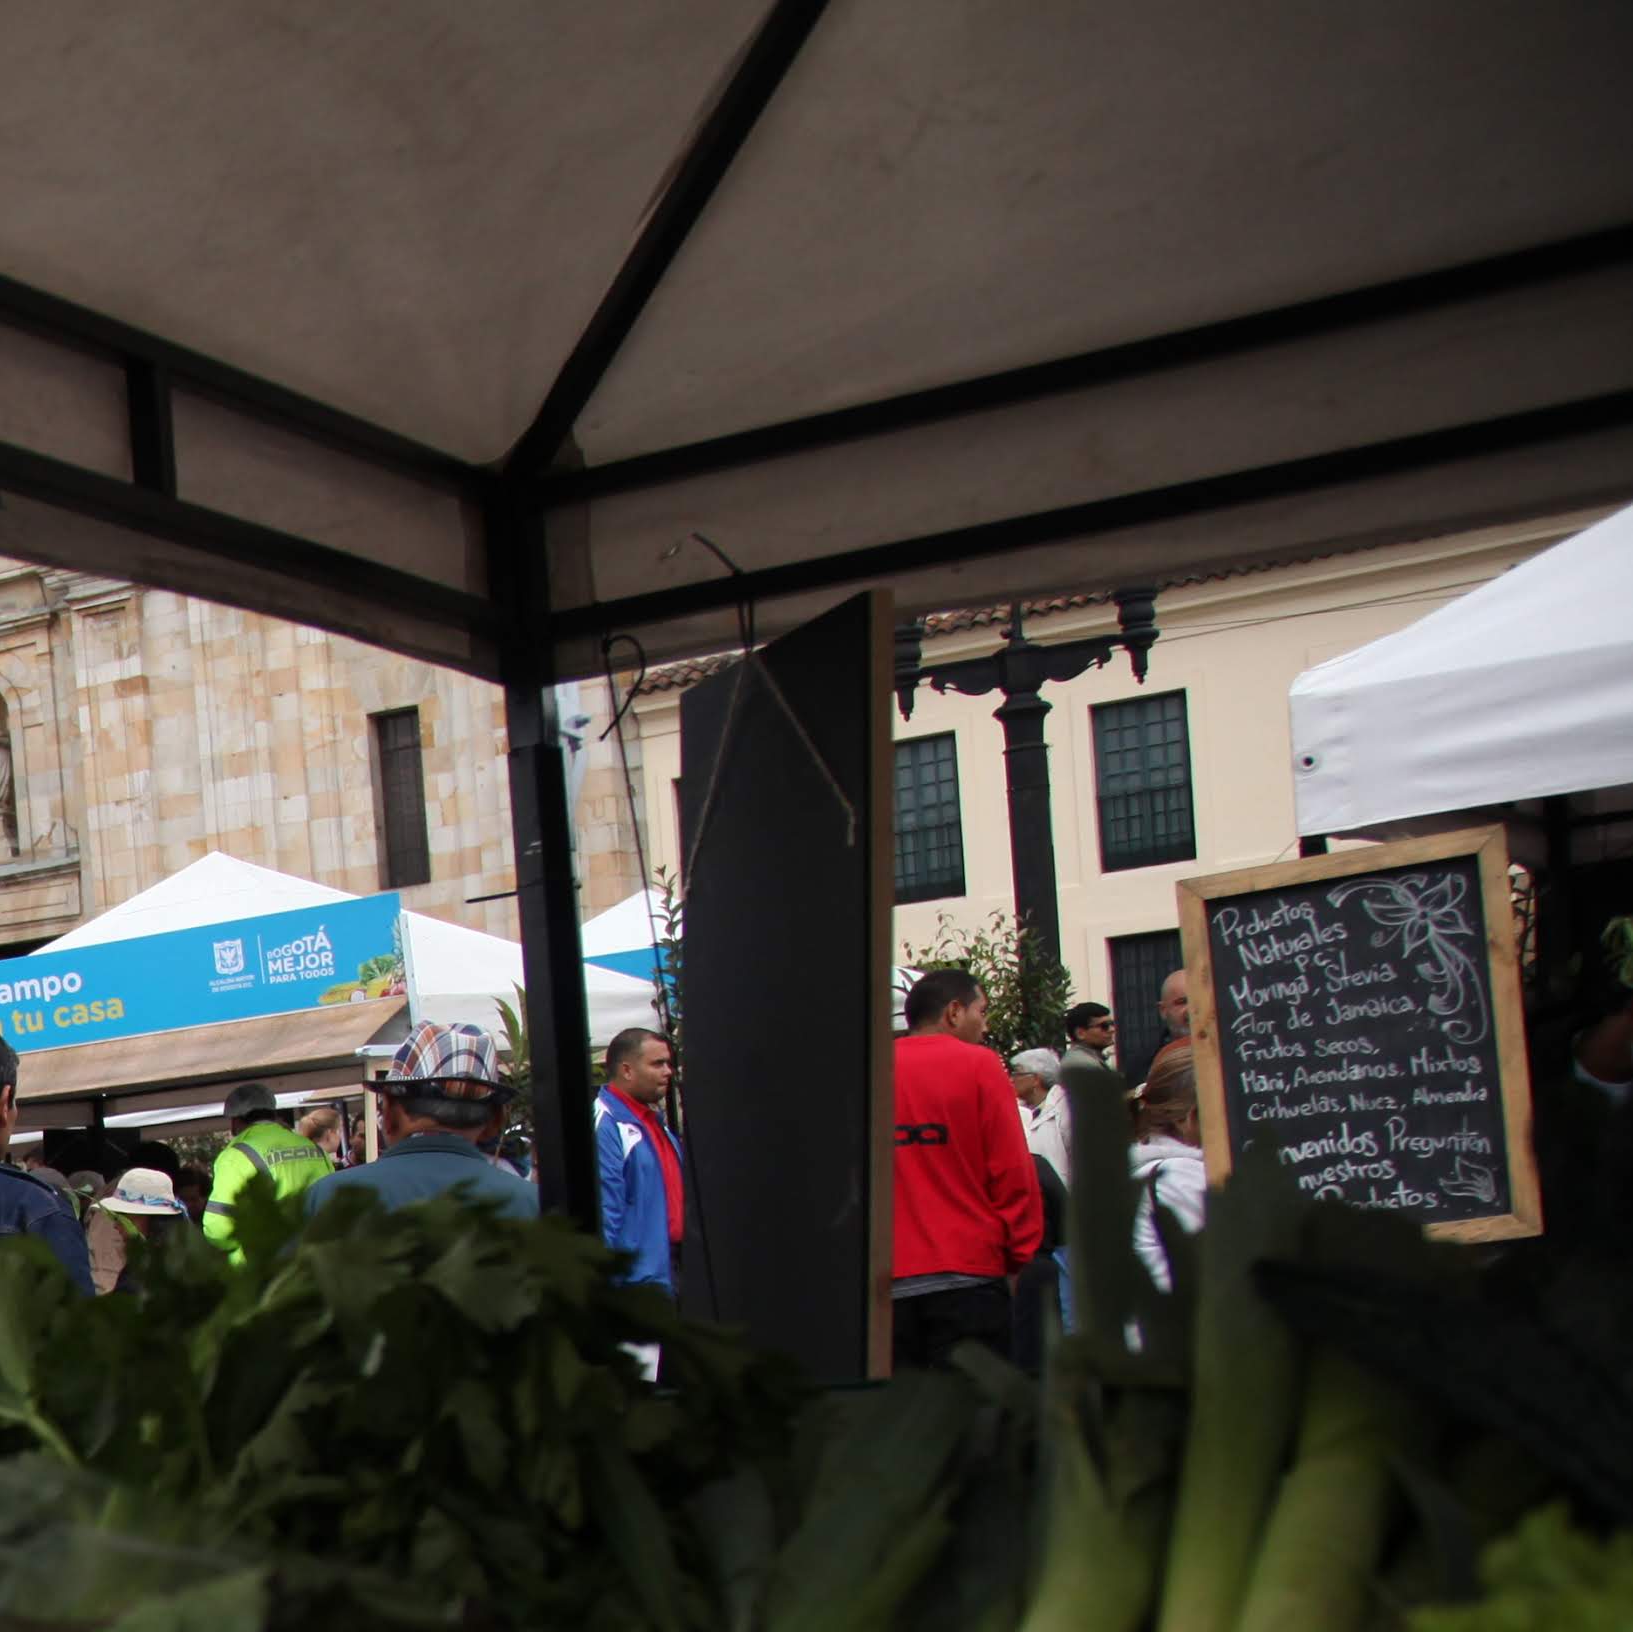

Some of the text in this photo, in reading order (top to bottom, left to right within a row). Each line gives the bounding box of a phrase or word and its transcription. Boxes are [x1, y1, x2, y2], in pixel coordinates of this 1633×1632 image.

[266, 924, 332, 960] BOGOTÁ
[1238, 917, 1348, 971] Naturales
[267, 951, 335, 975] MEJOR
[269, 973, 297, 984] PARA
[299, 967, 335, 980] TODOS
[1324, 950, 1398, 993] Stevia
[11, 1010, 45, 1035] tu
[53, 997, 124, 1028] casa
[1231, 1011, 1277, 1037] Flor
[1287, 1006, 1315, 1030] de
[1237, 1034, 1306, 1062] Frutos
[1410, 1045, 1483, 1077] Mixtos
[1298, 1158, 1397, 1190] nuestros
